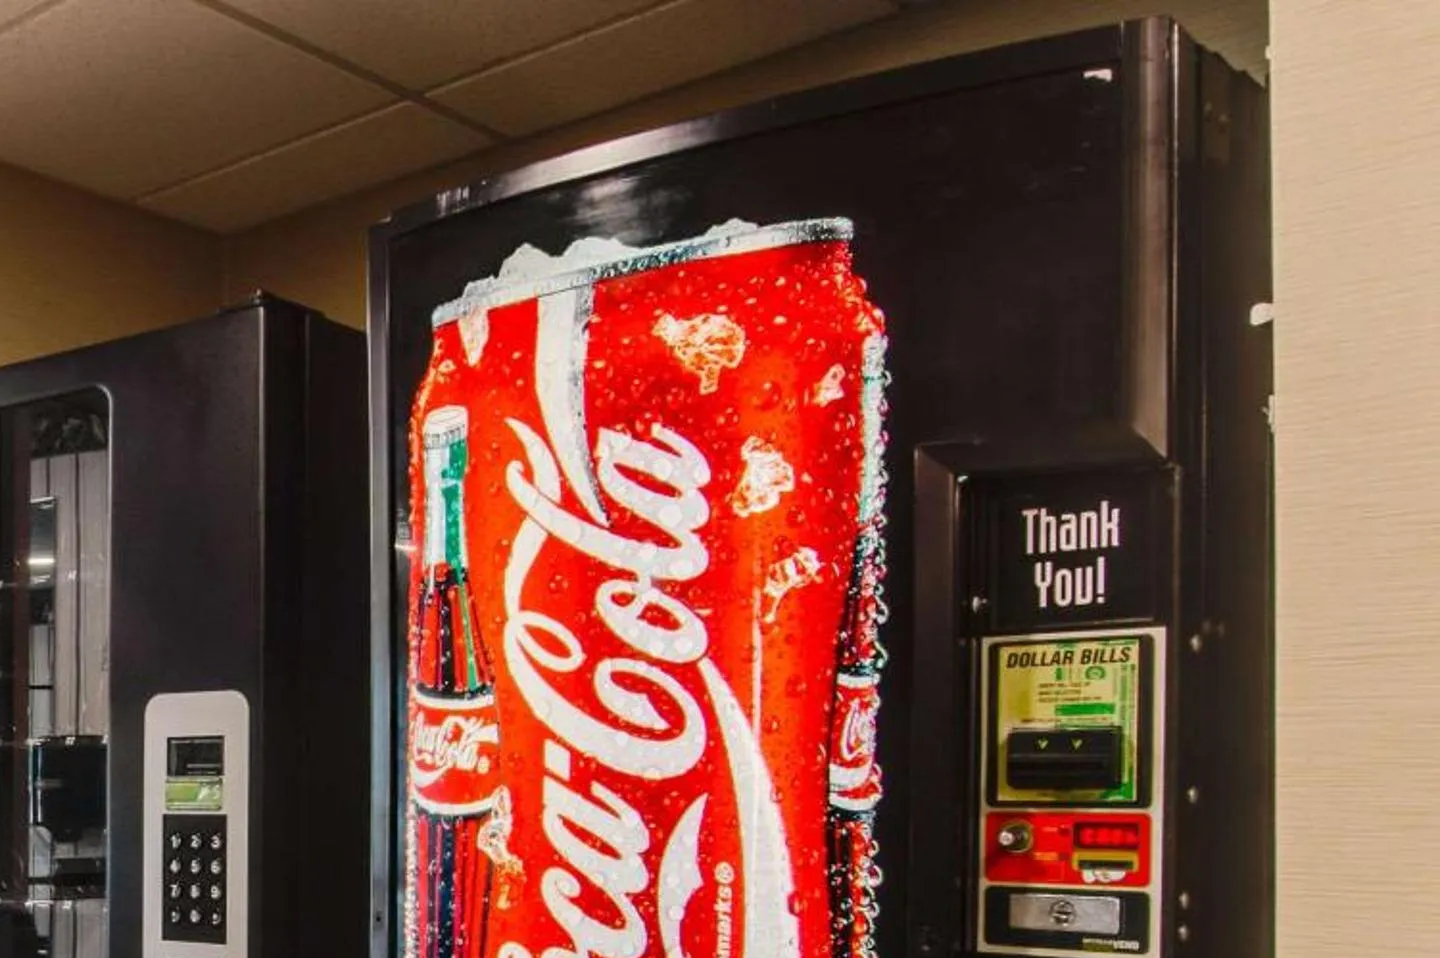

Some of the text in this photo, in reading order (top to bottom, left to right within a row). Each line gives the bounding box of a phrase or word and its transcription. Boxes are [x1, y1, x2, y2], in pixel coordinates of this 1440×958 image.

[1022, 500, 1120, 554] Thank
[1034, 556, 1105, 608] You!
[1006, 647, 1133, 669] DOLLAR BILLS
